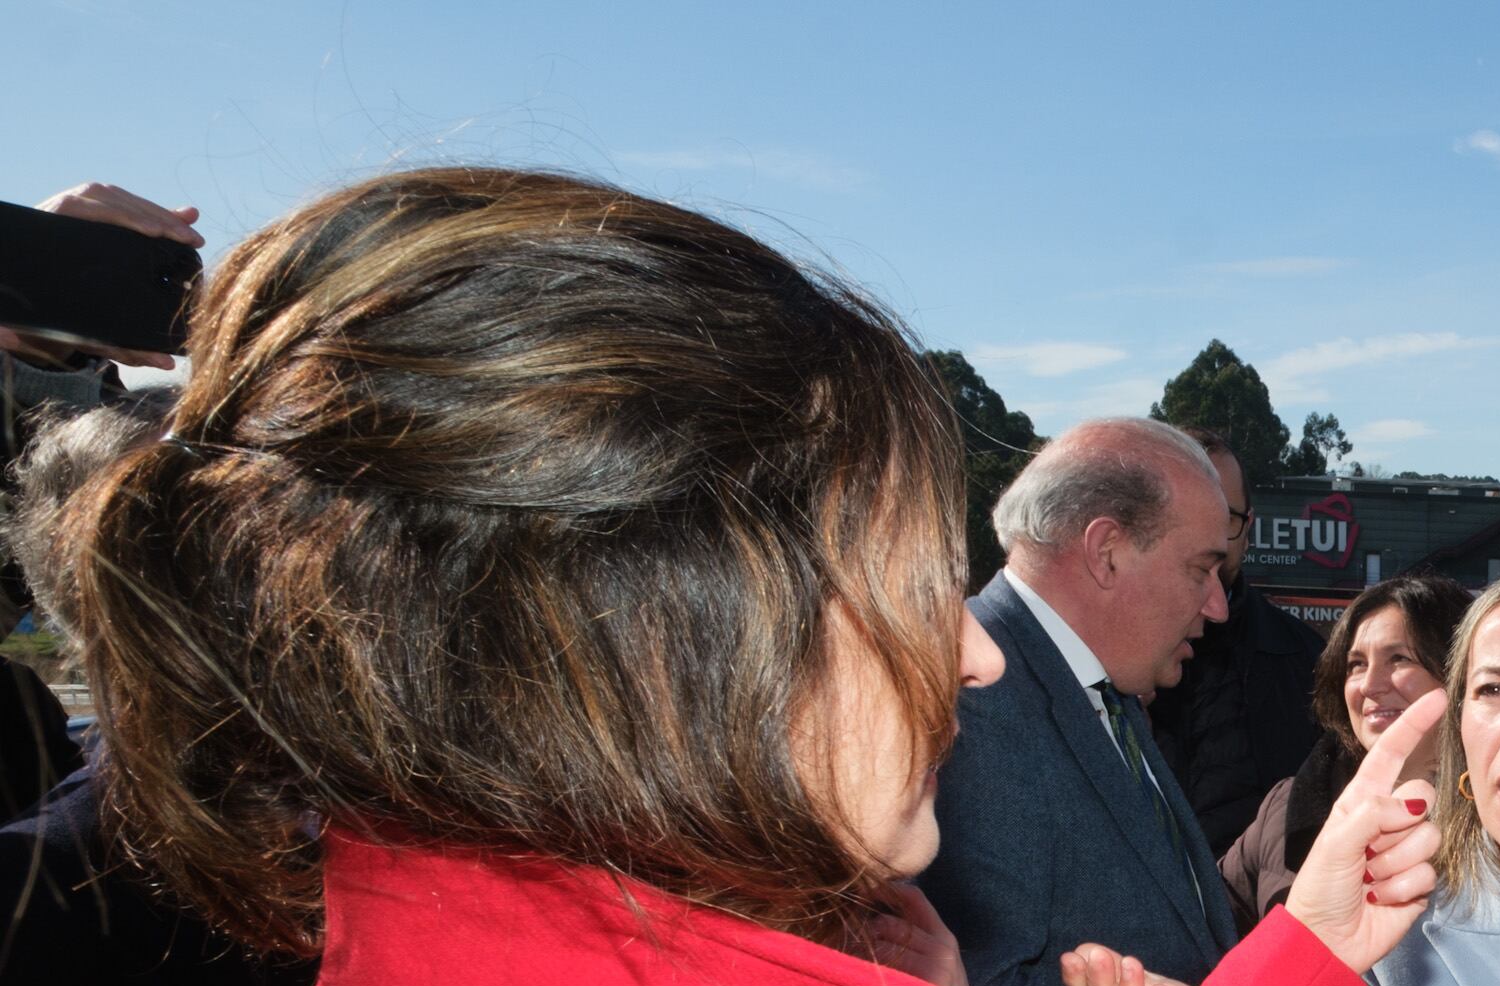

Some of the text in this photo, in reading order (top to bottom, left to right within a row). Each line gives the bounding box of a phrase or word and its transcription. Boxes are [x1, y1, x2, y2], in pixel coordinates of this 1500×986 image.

[1249, 517, 1347, 552] LETUI
[1242, 553, 1297, 565] ON CENTER
